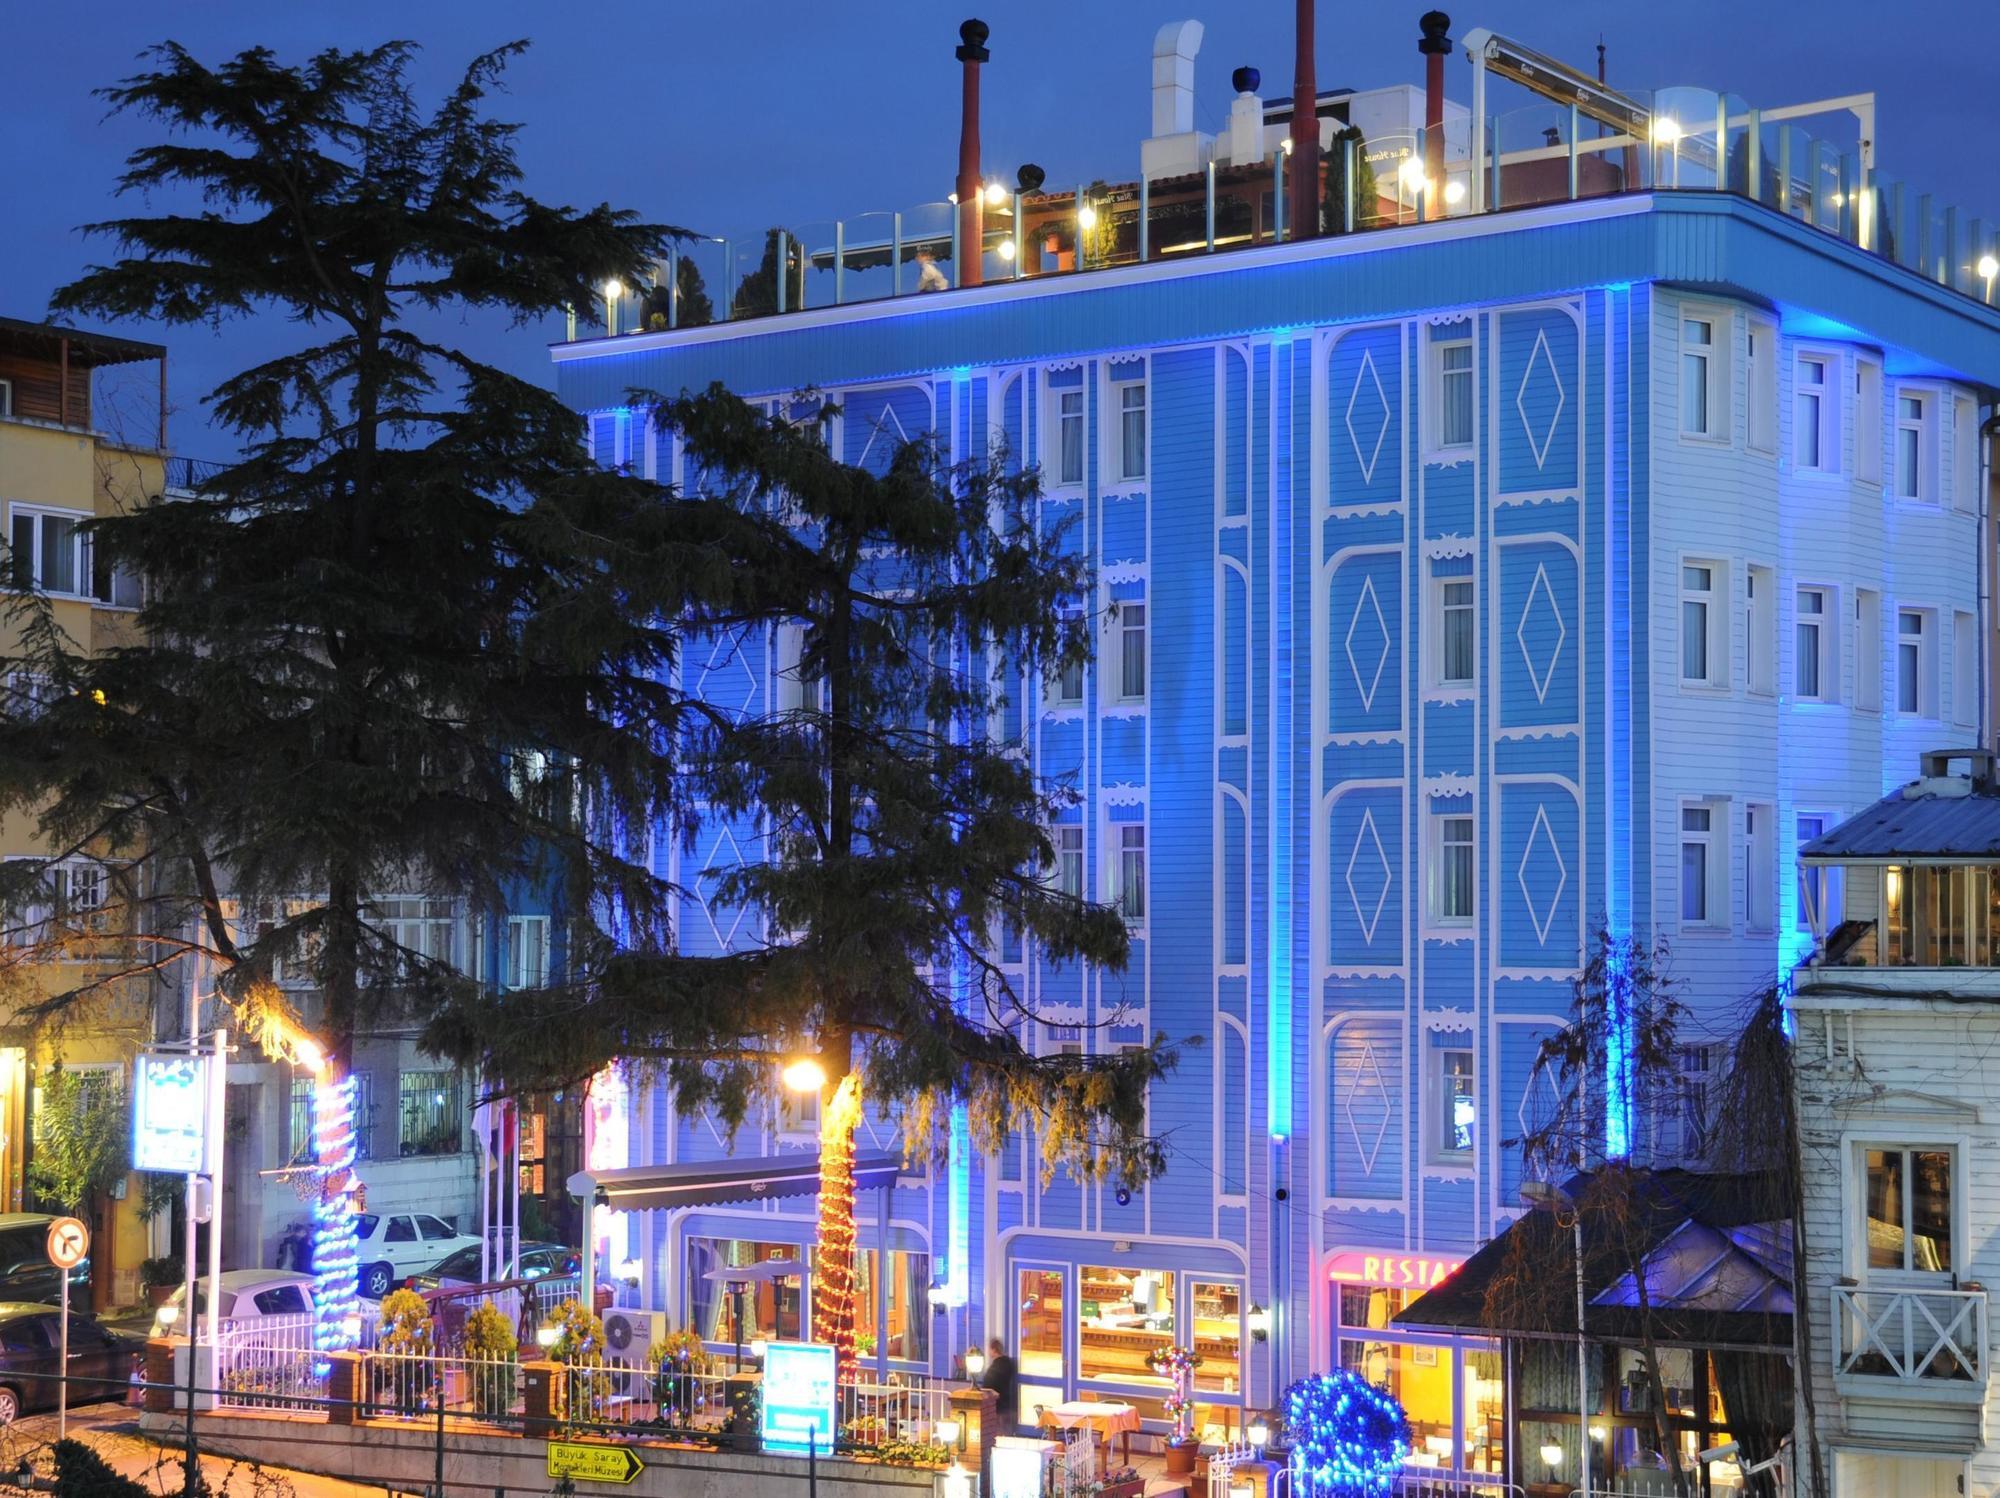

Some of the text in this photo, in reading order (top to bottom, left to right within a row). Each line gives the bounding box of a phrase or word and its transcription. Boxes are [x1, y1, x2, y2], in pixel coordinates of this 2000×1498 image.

[1364, 1256, 1460, 1286] RESTA
[557, 1448, 623, 1465] Büyük Saray
